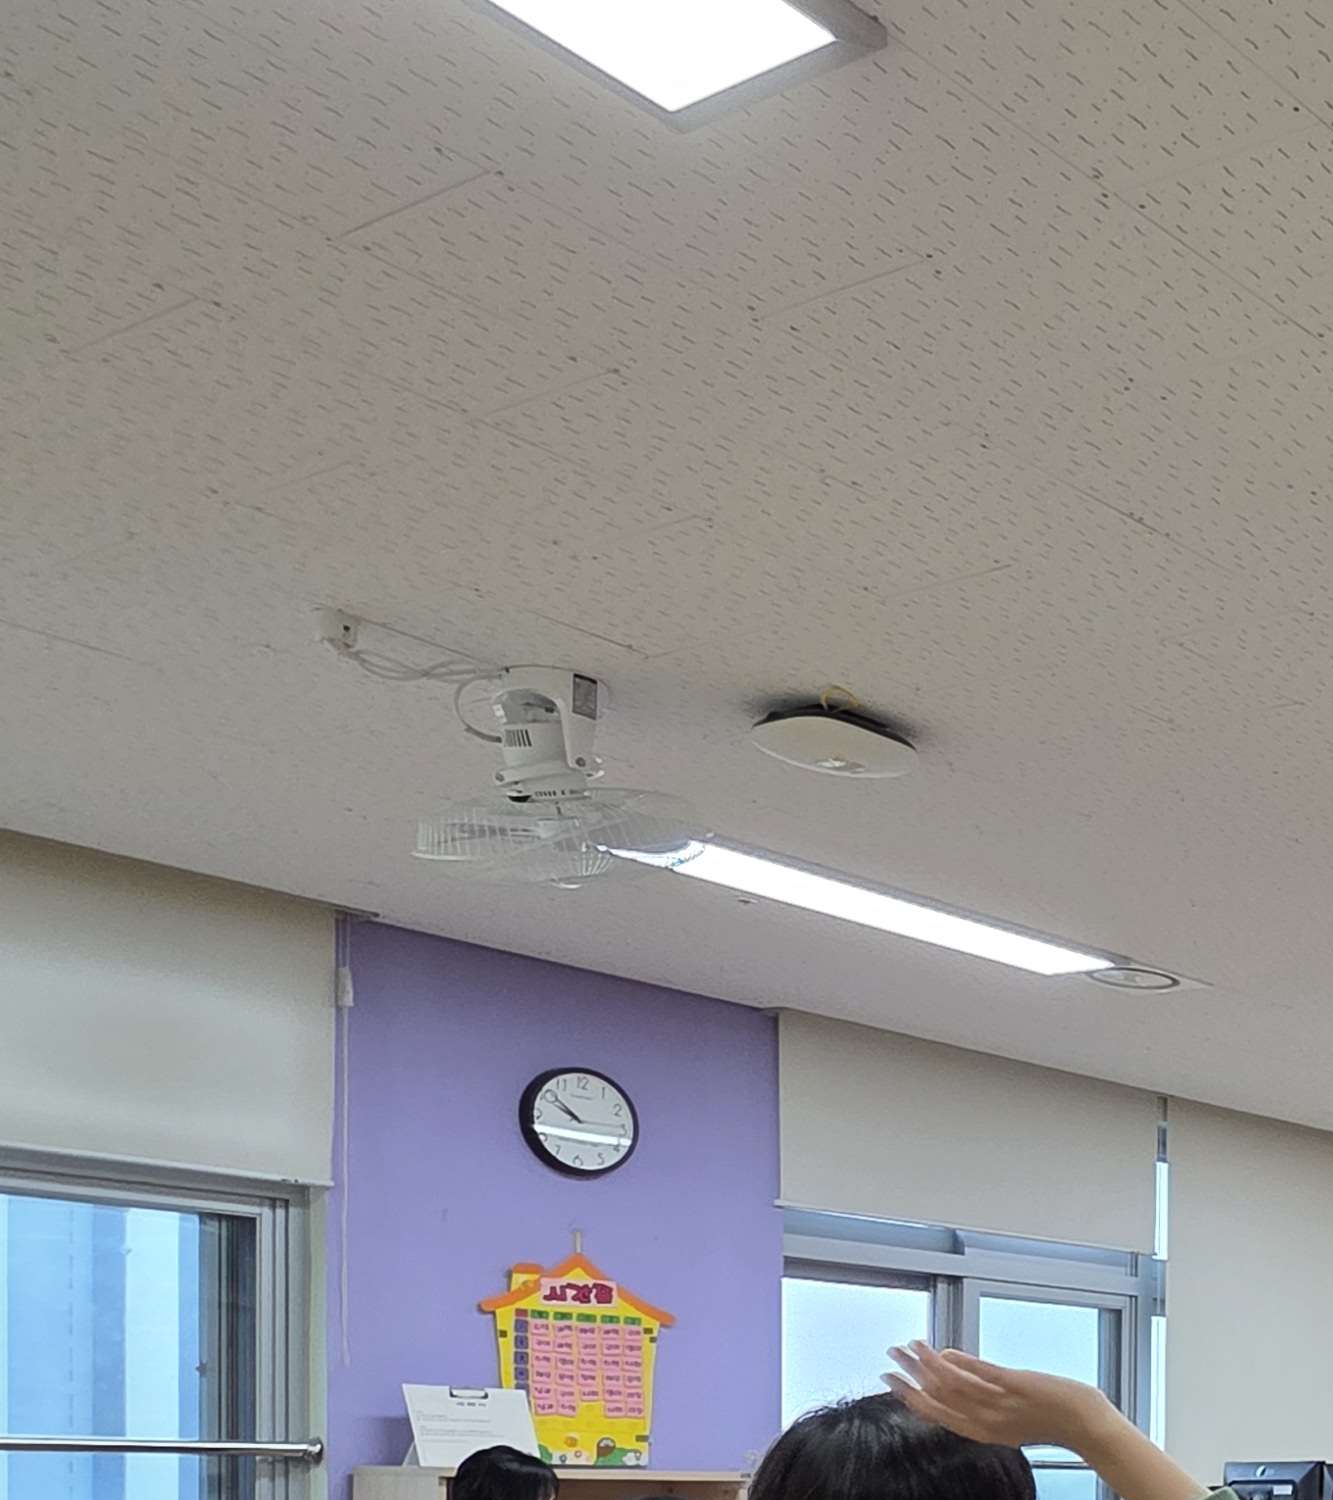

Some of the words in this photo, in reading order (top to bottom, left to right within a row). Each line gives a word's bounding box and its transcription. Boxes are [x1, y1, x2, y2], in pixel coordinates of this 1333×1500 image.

[577, 1076, 589, 1090] 12
[613, 1103, 622, 1117] 2
[543, 1282, 613, 1304] 시간표
